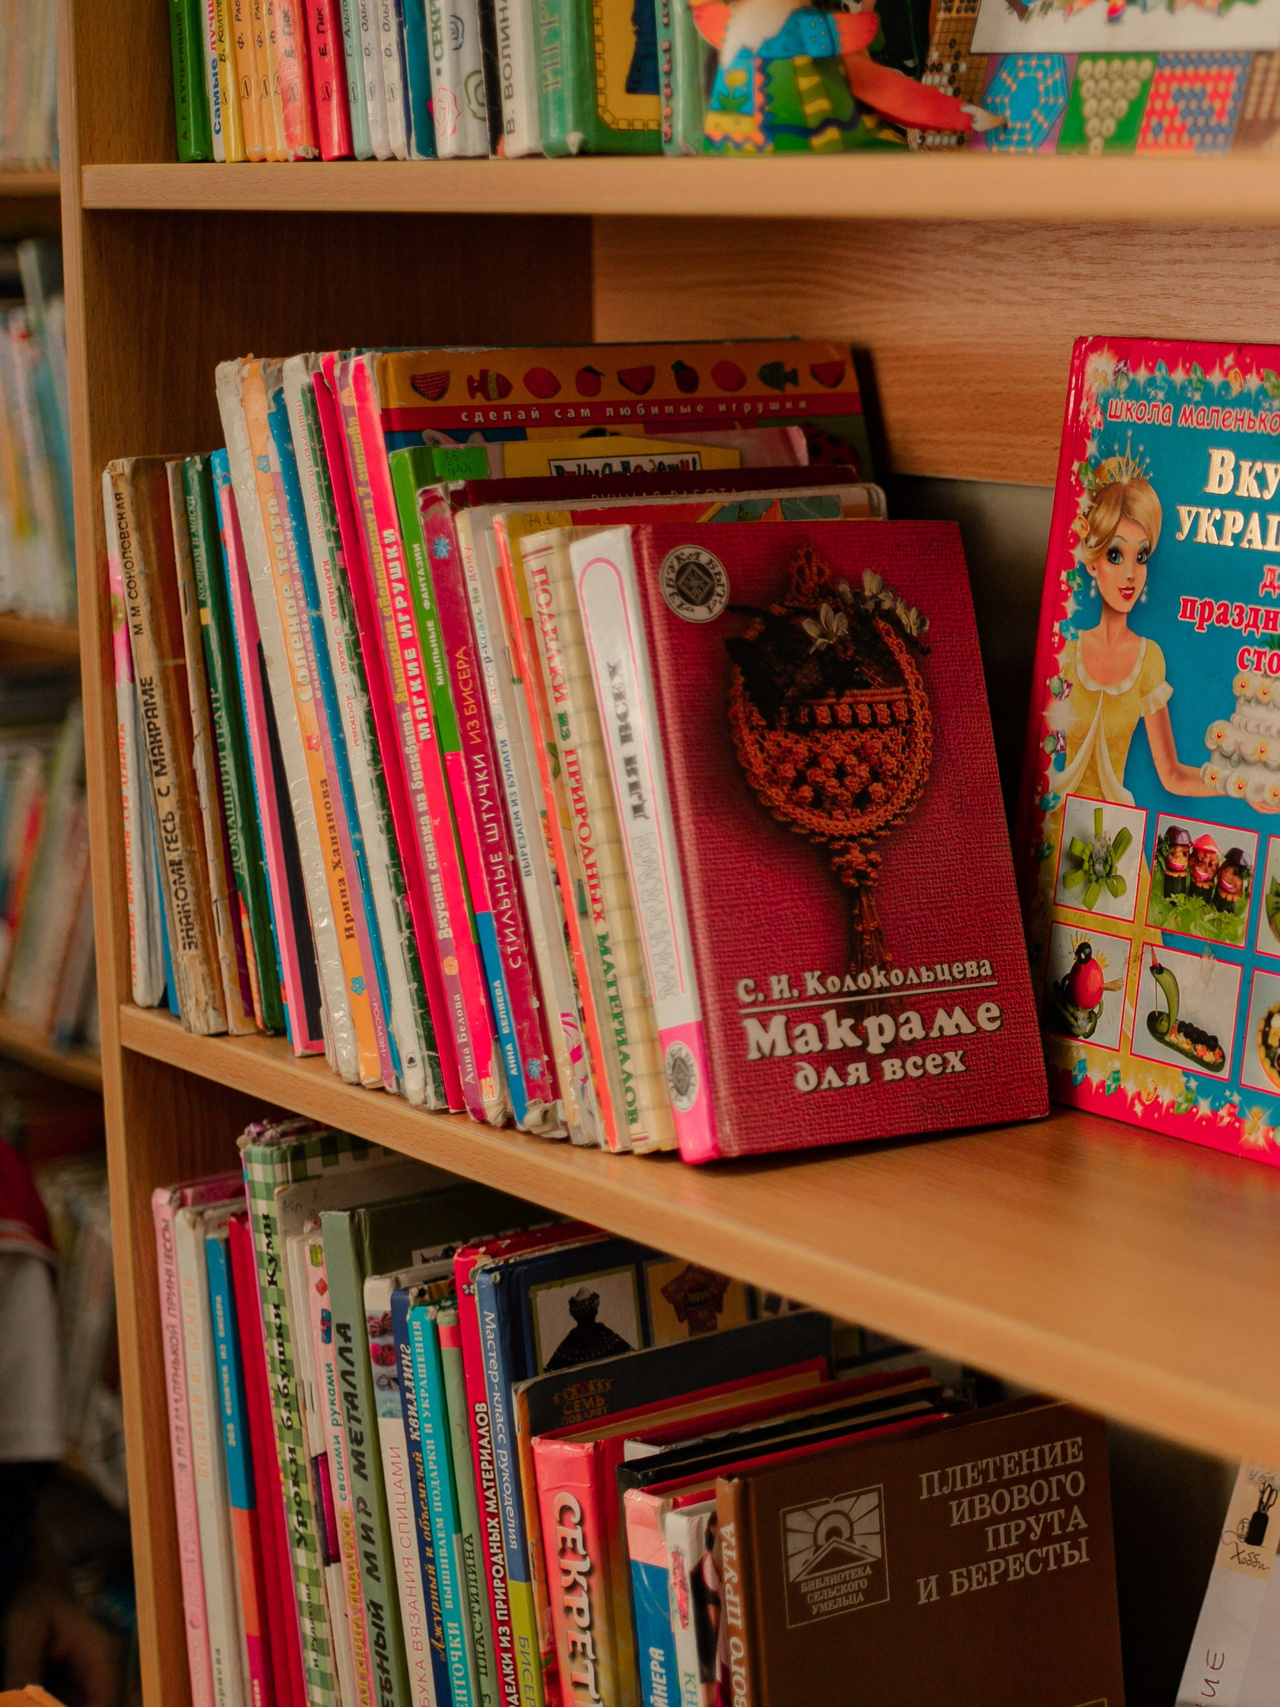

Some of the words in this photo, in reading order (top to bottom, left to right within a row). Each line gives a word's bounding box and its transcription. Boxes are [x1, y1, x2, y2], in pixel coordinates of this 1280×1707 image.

[427, 0, 444, 62] СЕКР
[210, 57, 221, 134] Самые
[506, 110, 516, 135] В.
[460, 406, 540, 423] сделай
[554, 408, 591, 419] сам
[606, 403, 704, 418] любимые
[718, 400, 807, 414] игрушки
[1107, 398, 1173, 426] школа
[294, 399, 306, 432] НАШИ
[300, 435, 311, 463] РУКИ
[312, 504, 324, 539] СКУКИ
[357, 484, 371, 496] 7
[112, 490, 139, 599] СОКОЛОВСКАЯ
[264, 496, 290, 575] тесто
[382, 527, 413, 639] ИГРУШКИ
[412, 541, 431, 610] ФАНТАЗИИ
[278, 581, 314, 703] Соленое
[321, 559, 339, 621] КАРНАВАЛ
[335, 641, 347, 675] МАСКИ
[344, 694, 360, 748] КОСТЮМЫ
[378, 619, 409, 703] Выпекаем
[425, 618, 445, 686] МЫЛЬНЫЕ
[403, 646, 431, 741] МЯГКИЕ
[452, 644, 478, 715] БИСЕРА
[605, 658, 635, 746] ВСЕХ
[139, 675, 168, 777] МАКРАМЕ
[465, 719, 483, 744] ИЗ
[156, 784, 171, 798] С
[499, 738, 515, 788] БУМАГИ
[622, 752, 651, 821] ДЛЯ
[317, 776, 344, 872] Хананова
[415, 791, 428, 812] из
[470, 752, 500, 843] ШТУЧКИ
[508, 790, 519, 807] ИЗ
[419, 814, 438, 870] сказка
[512, 810, 533, 877] ВЫРЕЗАЕМ
[529, 564, 570, 706] ПОДЕЛКИ
[561, 746, 607, 927] ПРИРОДНЫХ
[593, 930, 643, 1126] МАТЕРИАЛОВ
[334, 875, 357, 940] Ирина
[428, 871, 453, 939] Вкусная
[488, 850, 523, 969] СТИЛЬНЫЕ
[492, 978, 510, 1034] БЕЛЯЕВА
[736, 978, 765, 1003] С.
[769, 974, 800, 999] И.
[803, 957, 994, 998] Колокольцева
[371, 999, 386, 1055] РОСМЭН
[450, 993, 468, 1043] Белова
[742, 999, 1002, 1061] Макраме
[460, 1046, 475, 1085] Анна
[504, 1042, 518, 1076] АННА
[794, 1060, 870, 1092] для
[881, 1048, 968, 1082] всех
[259, 1211, 280, 1291] Куми
[187, 1360, 201, 1384] ИЗ
[267, 1301, 296, 1431] бабушки
[323, 1361, 342, 1428] руками
[397, 1341, 423, 1442] квиллинг
[411, 1318, 432, 1418] УКРАШЕНИЯ
[190, 1391, 209, 1479] ПОДЕЛКИ
[334, 1320, 369, 1482] МЕТАЛЛА
[423, 1422, 433, 1434] И
[481, 1309, 508, 1445] Мастер-класс
[495, 1448, 517, 1550] рукоделия
[331, 1433, 348, 1501] своими
[424, 1437, 444, 1512] ПОДАРКИ
[472, 1401, 498, 1514] МАТЕРИАЛОВ
[919, 1436, 1084, 1500] ПЛЕТЕНИЕ
[284, 1444, 310, 1548] Уроки
[387, 1444, 413, 1549] СПИЦАМИ
[949, 1470, 1086, 1528] ИВОВОГО
[984, 1504, 1089, 1552] ПРУТА
[338, 1507, 362, 1609] ПОДАРКОВ
[356, 1494, 380, 1584] МИР
[434, 1517, 454, 1609] ВЫШИВАЕМ
[485, 1516, 510, 1621] ПРИРОДНЫХ
[917, 1574, 940, 1604] И
[950, 1536, 1090, 1598] БЕРЕСТЫ
[1230, 1550, 1270, 1572] Хобби
[401, 1555, 424, 1652] ВЯЗАНИЯ
[462, 1532, 489, 1678] ПЛАСТИЛИНА
[718, 1521, 743, 1630] ПРУТА
[800, 1564, 873, 1593] БИБЛИОТЕКА
[806, 1577, 868, 1604] СЕЛЬСКОГО
[812, 1591, 865, 1616] УМЕЛЬЦА
[350, 1612, 368, 1676] КНИГА
[496, 1625, 512, 1647] ИЗ
